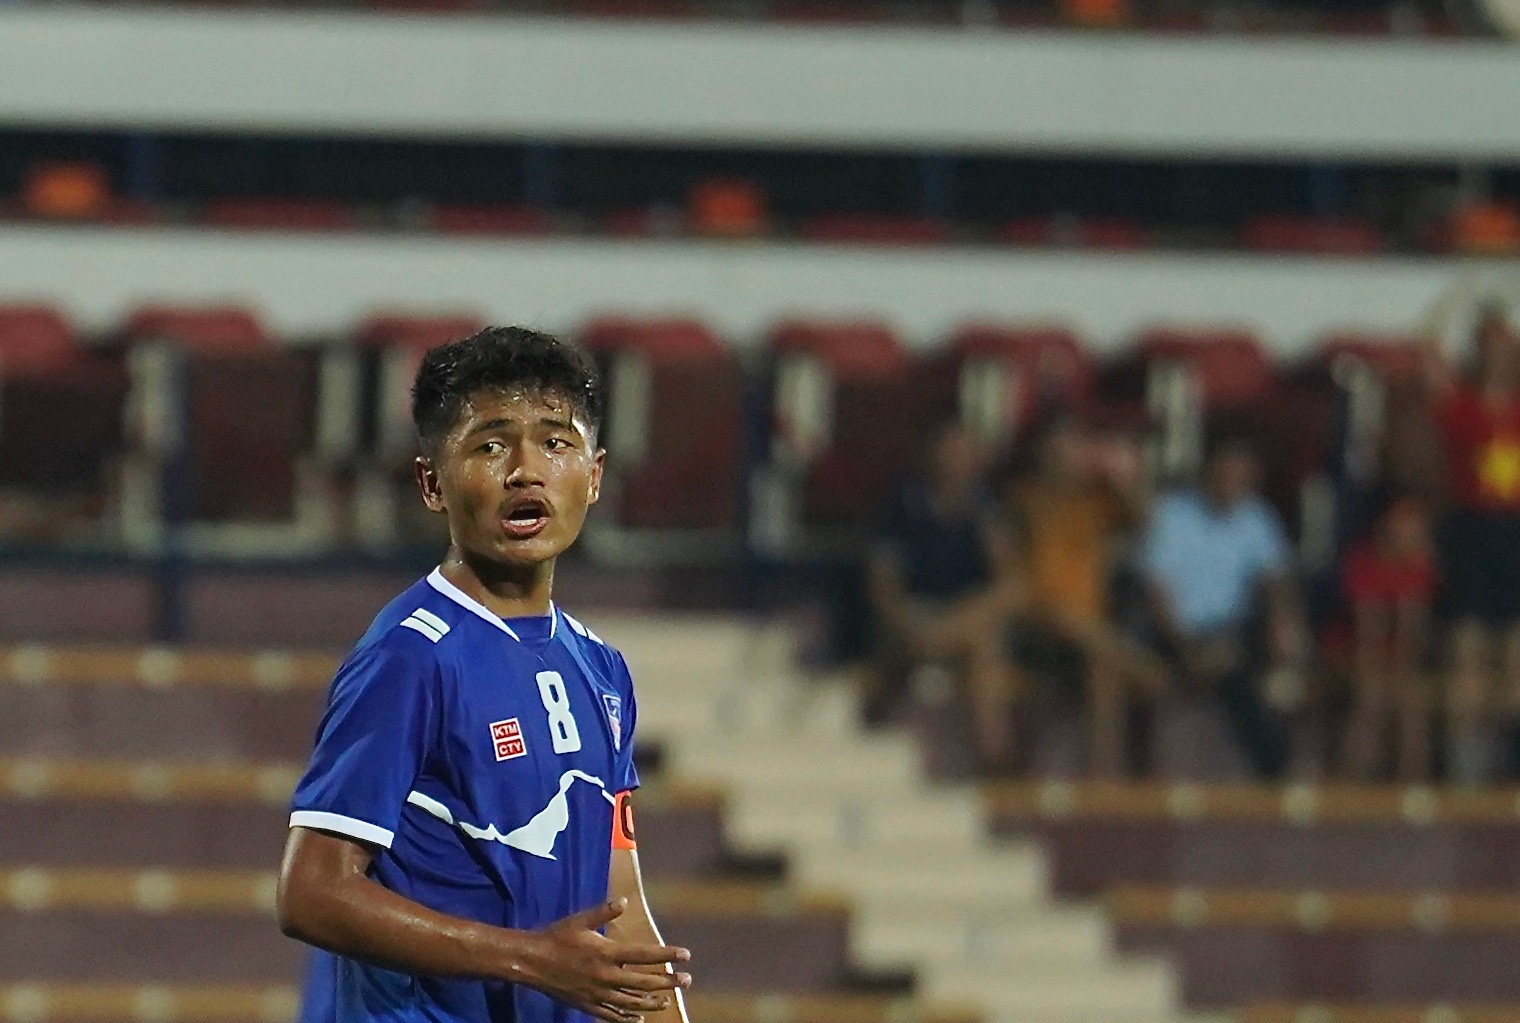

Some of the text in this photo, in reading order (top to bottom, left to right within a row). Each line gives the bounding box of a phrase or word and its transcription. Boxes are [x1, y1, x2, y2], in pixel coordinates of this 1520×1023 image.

[536, 671, 581, 754] 8
[494, 723, 517, 737] KTM
[498, 741, 521, 755] CTY
